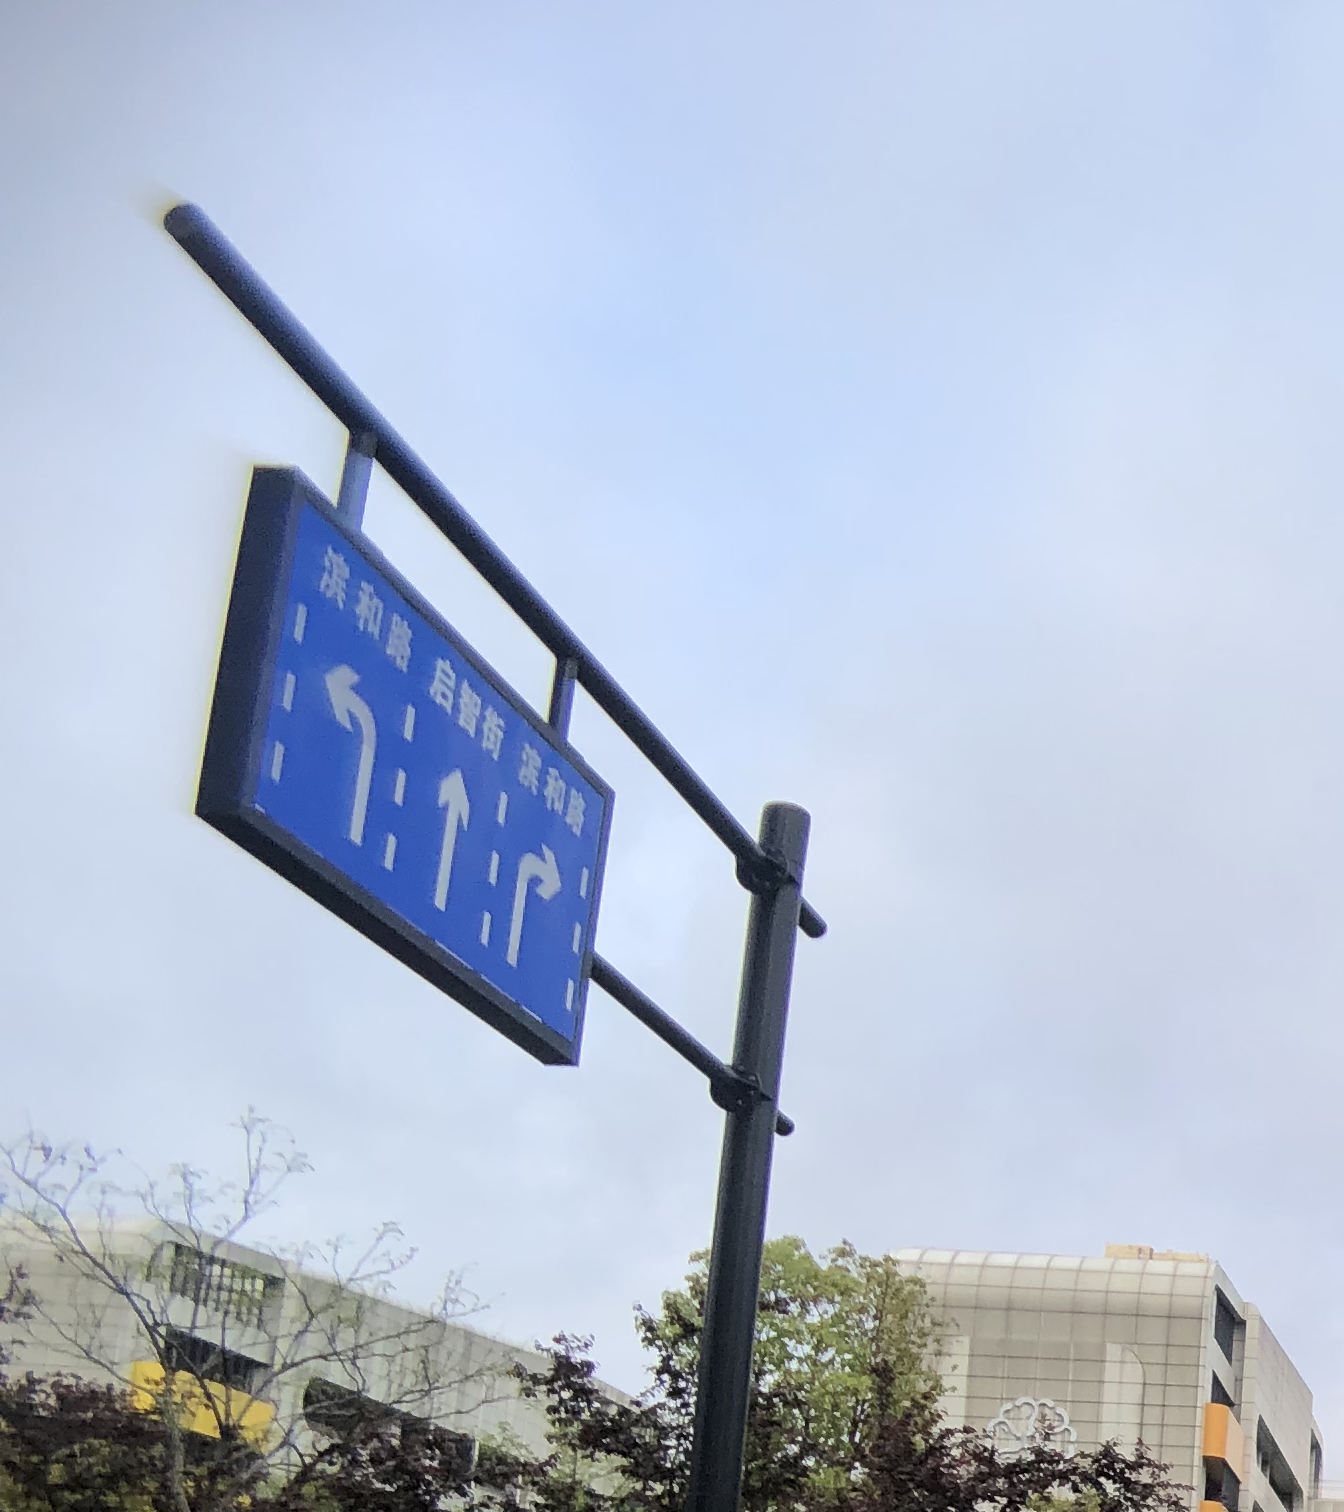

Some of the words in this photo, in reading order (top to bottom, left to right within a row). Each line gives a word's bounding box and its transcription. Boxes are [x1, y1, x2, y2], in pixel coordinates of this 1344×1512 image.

[319, 545, 413, 673] 滨和路
[430, 657, 505, 761] 启智街
[519, 743, 587, 837] 滨和路
